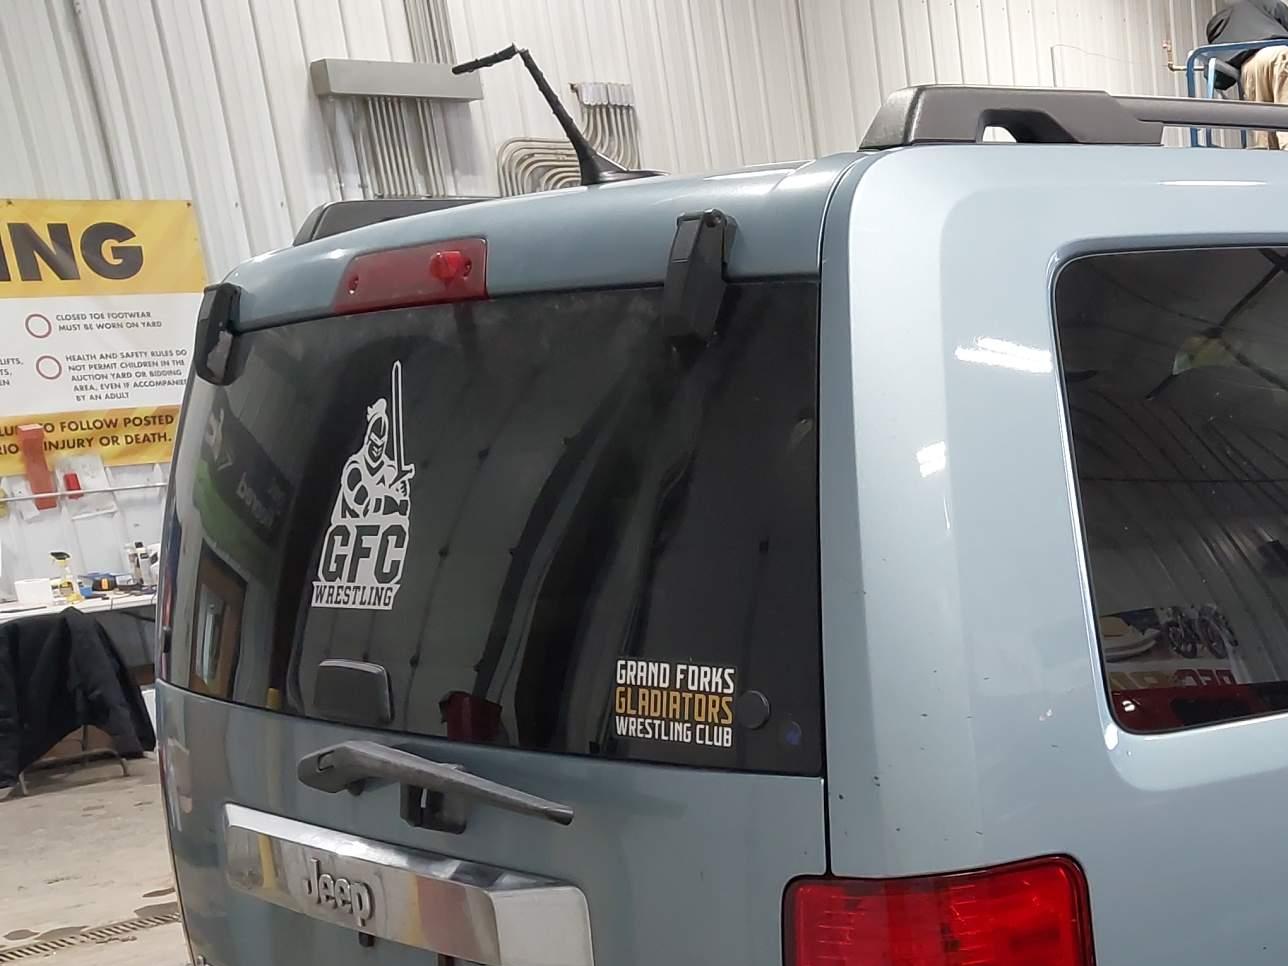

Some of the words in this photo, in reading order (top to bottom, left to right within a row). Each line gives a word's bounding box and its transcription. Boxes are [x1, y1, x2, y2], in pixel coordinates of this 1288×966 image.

[56, 313, 87, 321] CLOSED
[89, 312, 105, 320] TOE
[107, 311, 151, 320] FOOTWEAR
[95, 322, 123, 330] WORN
[65, 354, 96, 362] HEALTH
[99, 352, 118, 360] AND
[68, 364, 86, 372] NOT
[88, 362, 117, 370] PERMIT
[120, 361, 159, 369] CHILDREN
[71, 374, 108, 382] AUCTION
[149, 369, 182, 377] BIDDING
[100, 382, 121, 390] EVEN
[104, 392, 129, 400] ADULT
[60, 418, 118, 432] FOLLOW
[123, 414, 175, 428] POSTED
[44, 436, 94, 451] INJURY
[99, 435, 120, 446] OR
[124, 432, 173, 445] DEATH.
[321, 524, 407, 584] GFC
[314, 584, 393, 607] WRESTLING
[616, 659, 670, 688] GRAND
[676, 664, 735, 695] FORKS
[615, 686, 733, 725] GLADIATORS
[615, 715, 691, 743] WRESTLING
[696, 724, 733, 748] CLUB
[303, 856, 375, 929] Jeep
